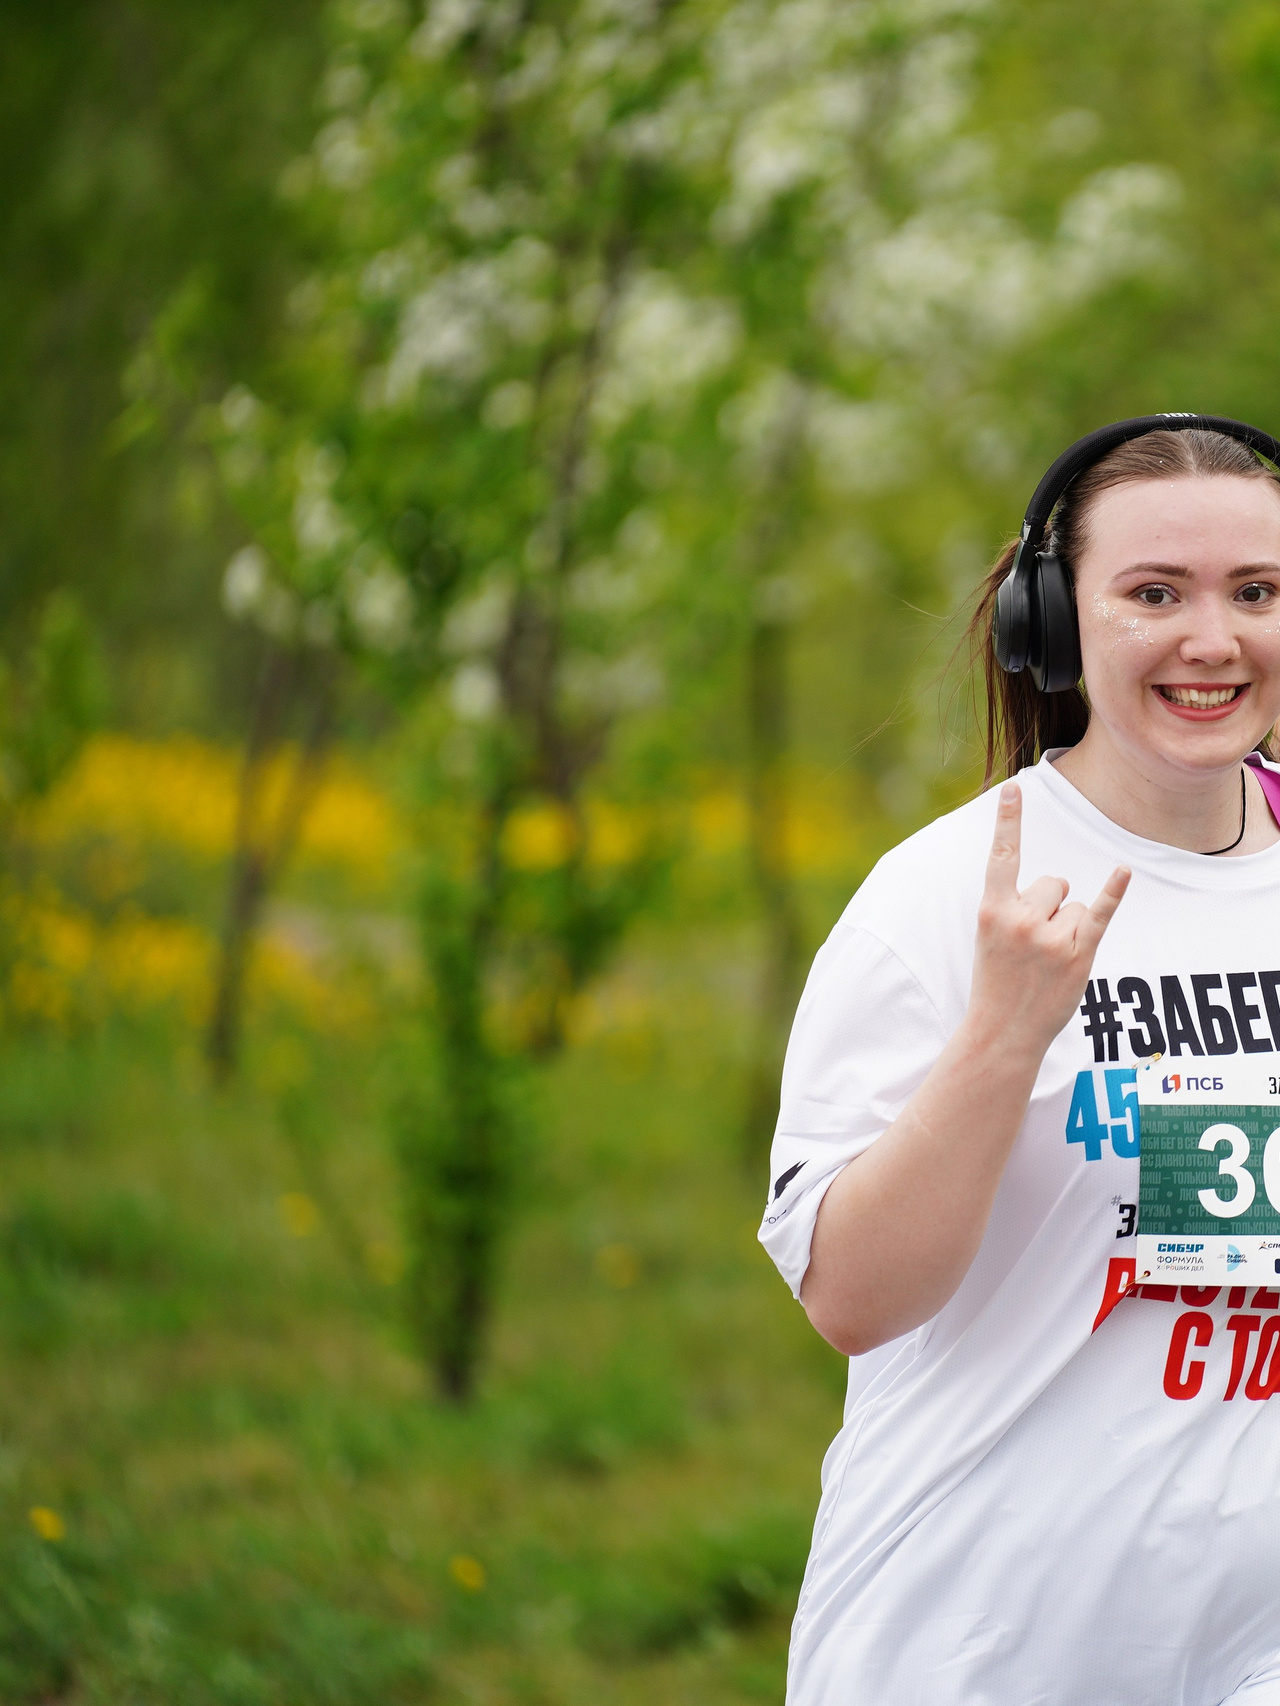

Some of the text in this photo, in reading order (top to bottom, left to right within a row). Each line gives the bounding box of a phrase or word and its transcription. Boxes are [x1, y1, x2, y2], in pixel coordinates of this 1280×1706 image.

[1186, 1077, 1224, 1090] ПСБ
[1140, 1121, 1169, 1134] АЧАЛО
[1140, 1136, 1160, 1150] ЮБИ
[1157, 1243, 1204, 1253] СИБУР
[1156, 1256, 1204, 1264] ФОРМУЛА
[1162, 1311, 1214, 1401] С
